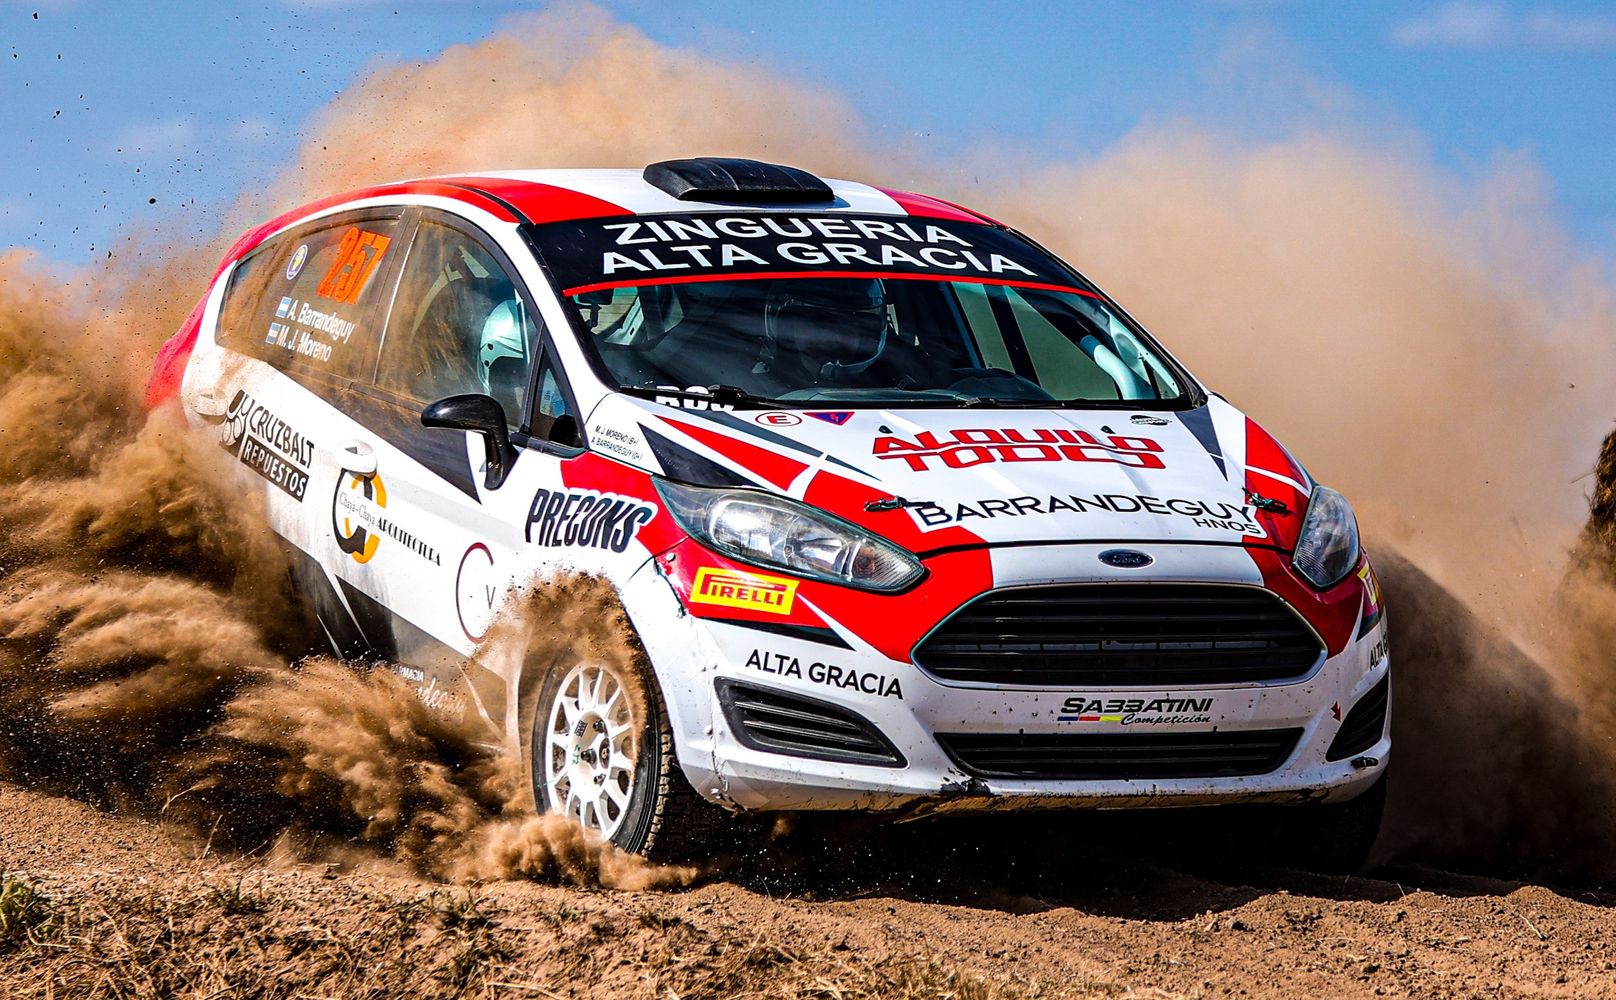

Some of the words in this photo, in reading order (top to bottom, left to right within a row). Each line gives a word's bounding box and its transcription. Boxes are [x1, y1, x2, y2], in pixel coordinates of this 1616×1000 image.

[603, 216, 974, 248] ZINGUERIA
[316, 226, 393, 305] 257
[603, 242, 770, 275] ALTA
[777, 242, 1038, 277] GRACIA
[286, 299, 297, 321] A.
[297, 302, 356, 345] Barrandeguy
[275, 325, 288, 348] M.
[296, 331, 333, 362] Moreno
[249, 405, 315, 469] CRUZBALT
[605, 428, 628, 443] MORENO
[243, 439, 307, 497] REPUESTOS
[525, 488, 652, 554] PRECONS
[916, 494, 1250, 528] BARRANDEGUY
[1191, 517, 1262, 536] HNOS
[700, 573, 789, 606] PIRELLI
[745, 648, 802, 680] ALTA
[808, 662, 904, 700] GRACIA
[1060, 697, 1213, 714] SABBATINI
[1120, 712, 1212, 726] Competición
